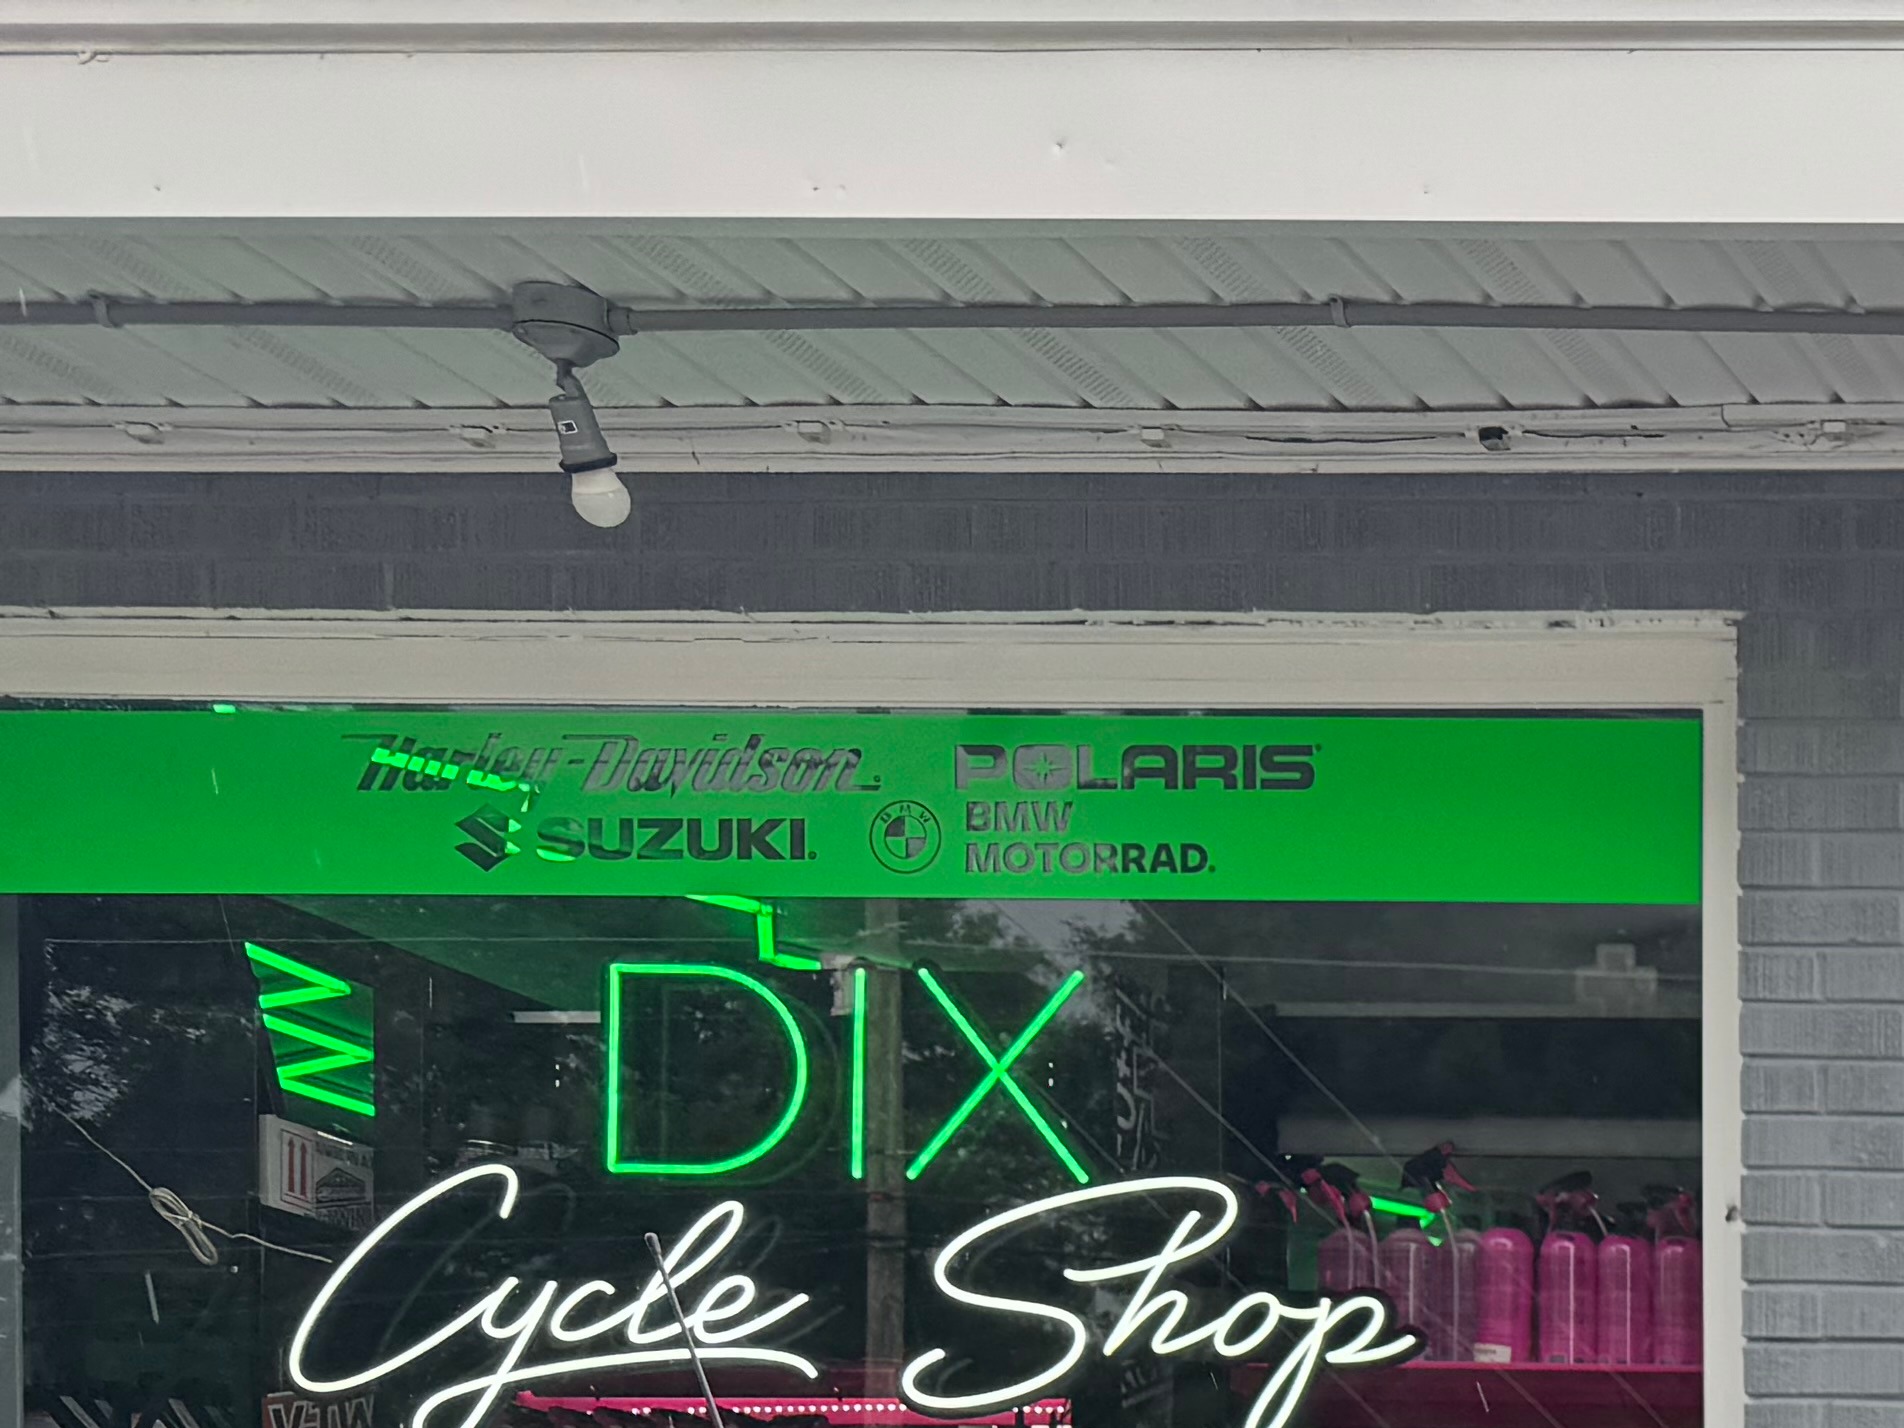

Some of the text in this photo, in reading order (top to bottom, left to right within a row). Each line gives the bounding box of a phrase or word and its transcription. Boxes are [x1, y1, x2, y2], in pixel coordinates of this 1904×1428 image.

[955, 744, 1316, 791] POLARIS
[966, 801, 1073, 832] BMW
[606, 962, 1091, 1184] DIX
